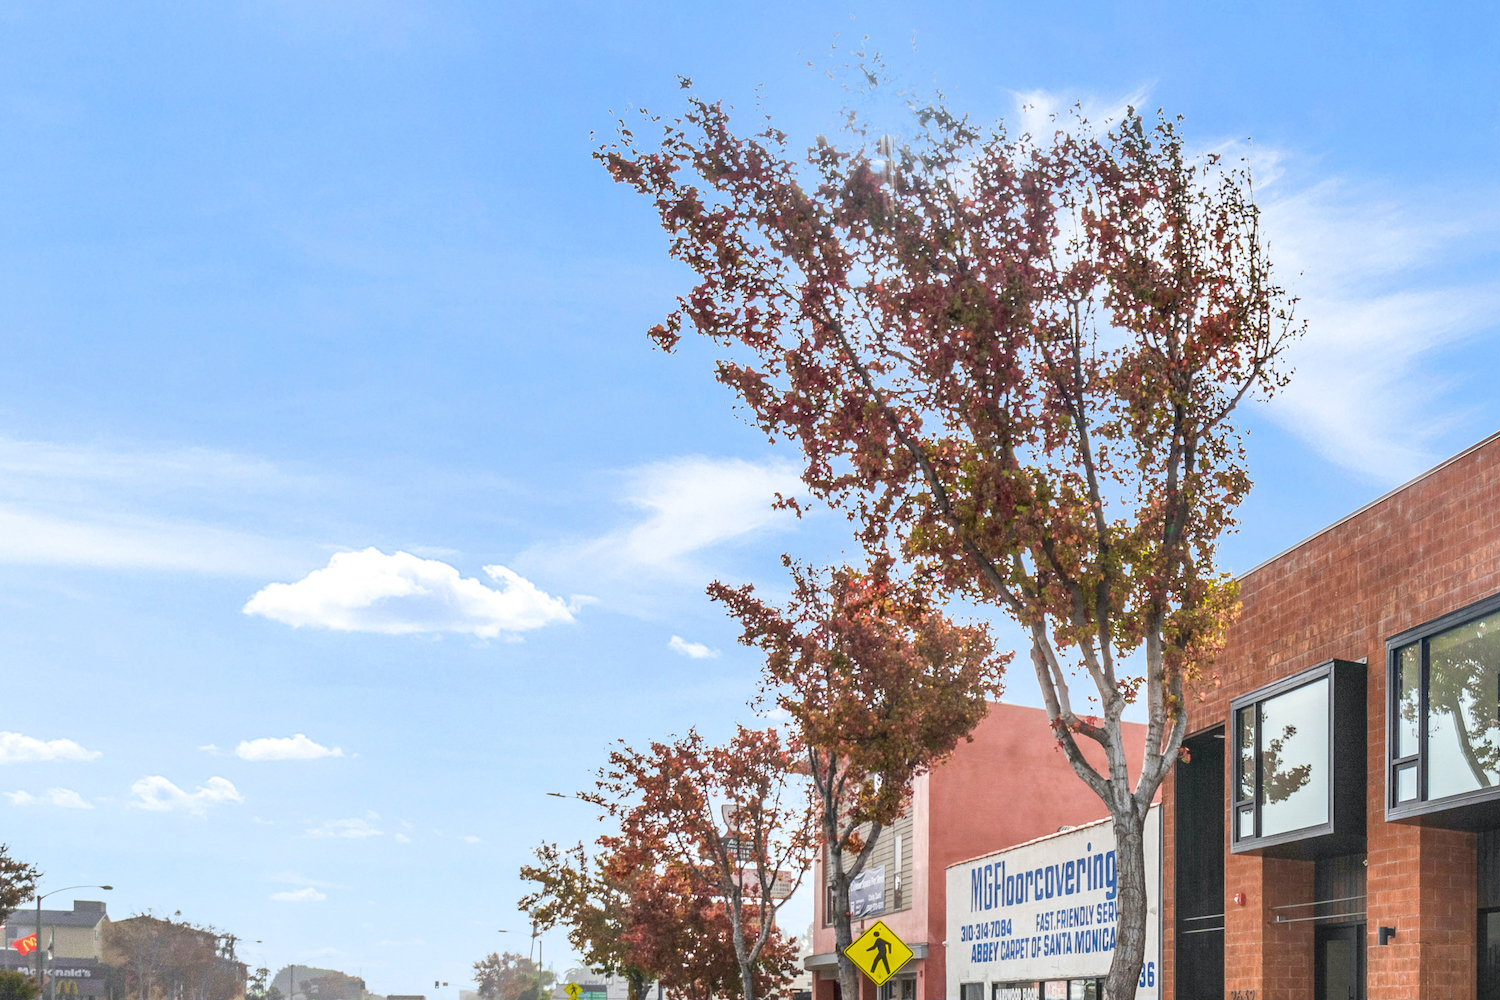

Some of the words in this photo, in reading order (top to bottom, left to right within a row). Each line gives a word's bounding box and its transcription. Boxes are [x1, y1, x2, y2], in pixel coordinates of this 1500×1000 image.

[971, 941, 999, 963] ABBEY
[1000, 937, 1030, 961] CARPET
[1031, 936, 1042, 958] OF
[1044, 932, 1073, 956] SANTA
[1074, 926, 1116, 954] MONICA
